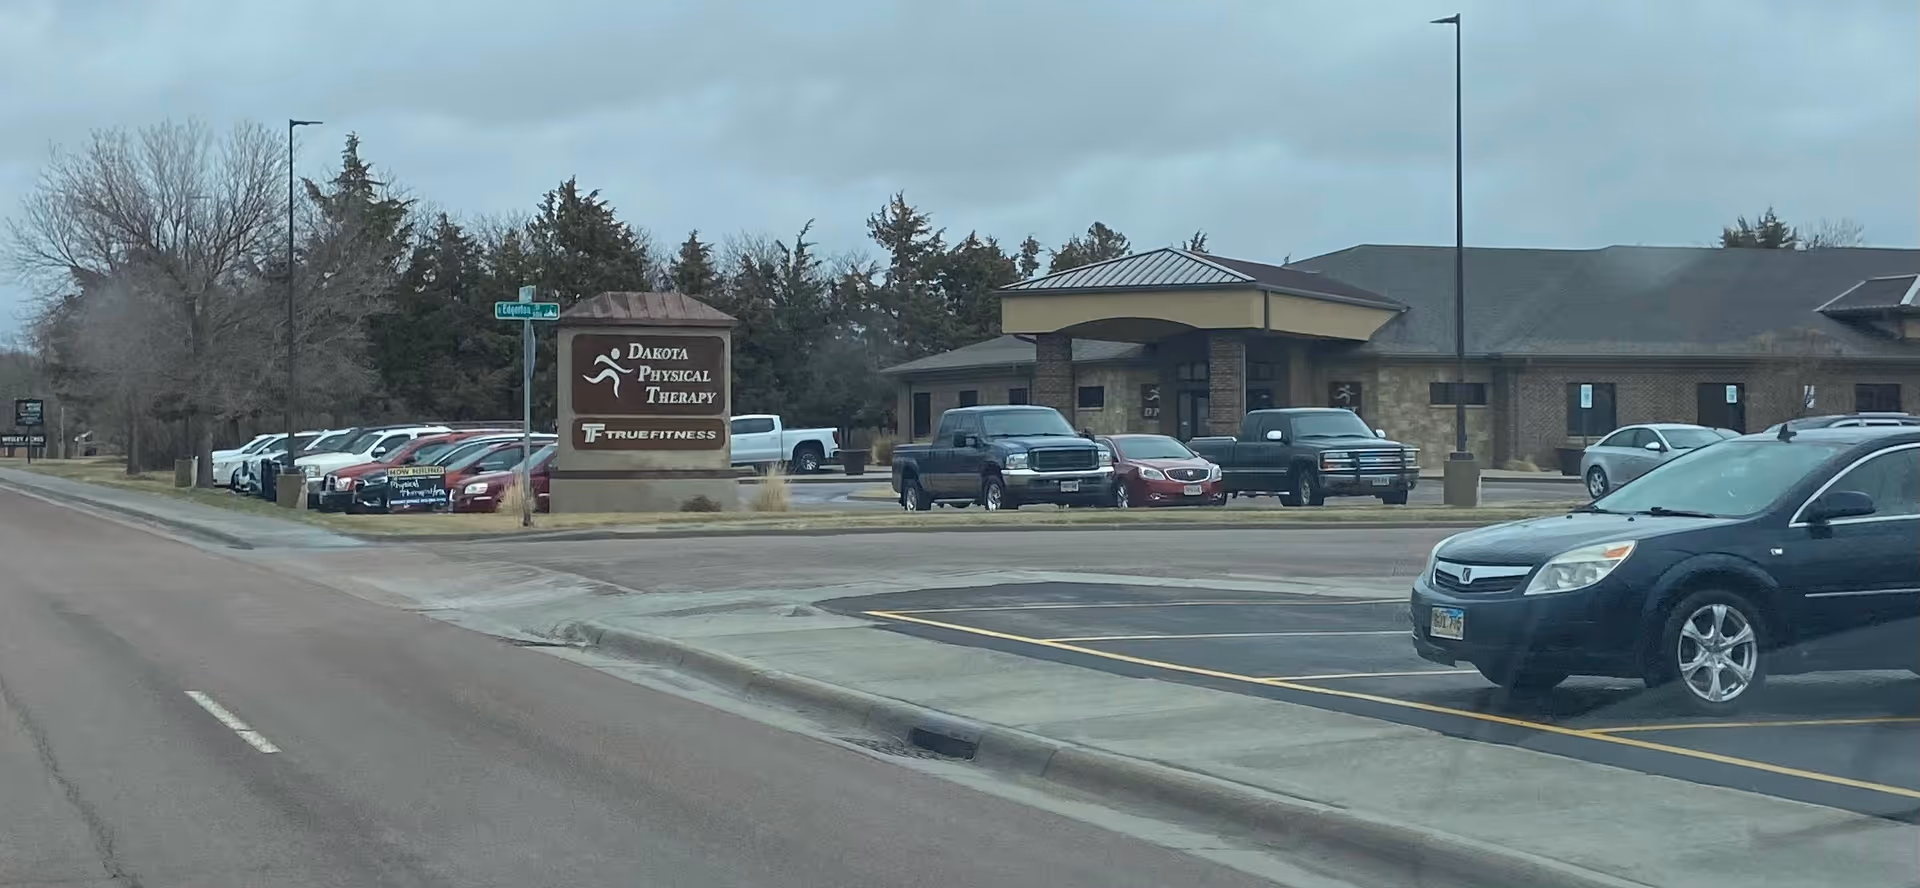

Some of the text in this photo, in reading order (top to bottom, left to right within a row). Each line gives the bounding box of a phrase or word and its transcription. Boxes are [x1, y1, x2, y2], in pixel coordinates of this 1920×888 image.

[502, 304, 531, 317] Edgerton
[627, 343, 689, 360] DAKOTA
[637, 365, 712, 382] PHYSICAL
[645, 386, 717, 404] THERAPY
[390, 466, 443, 476] NOW HIRING
